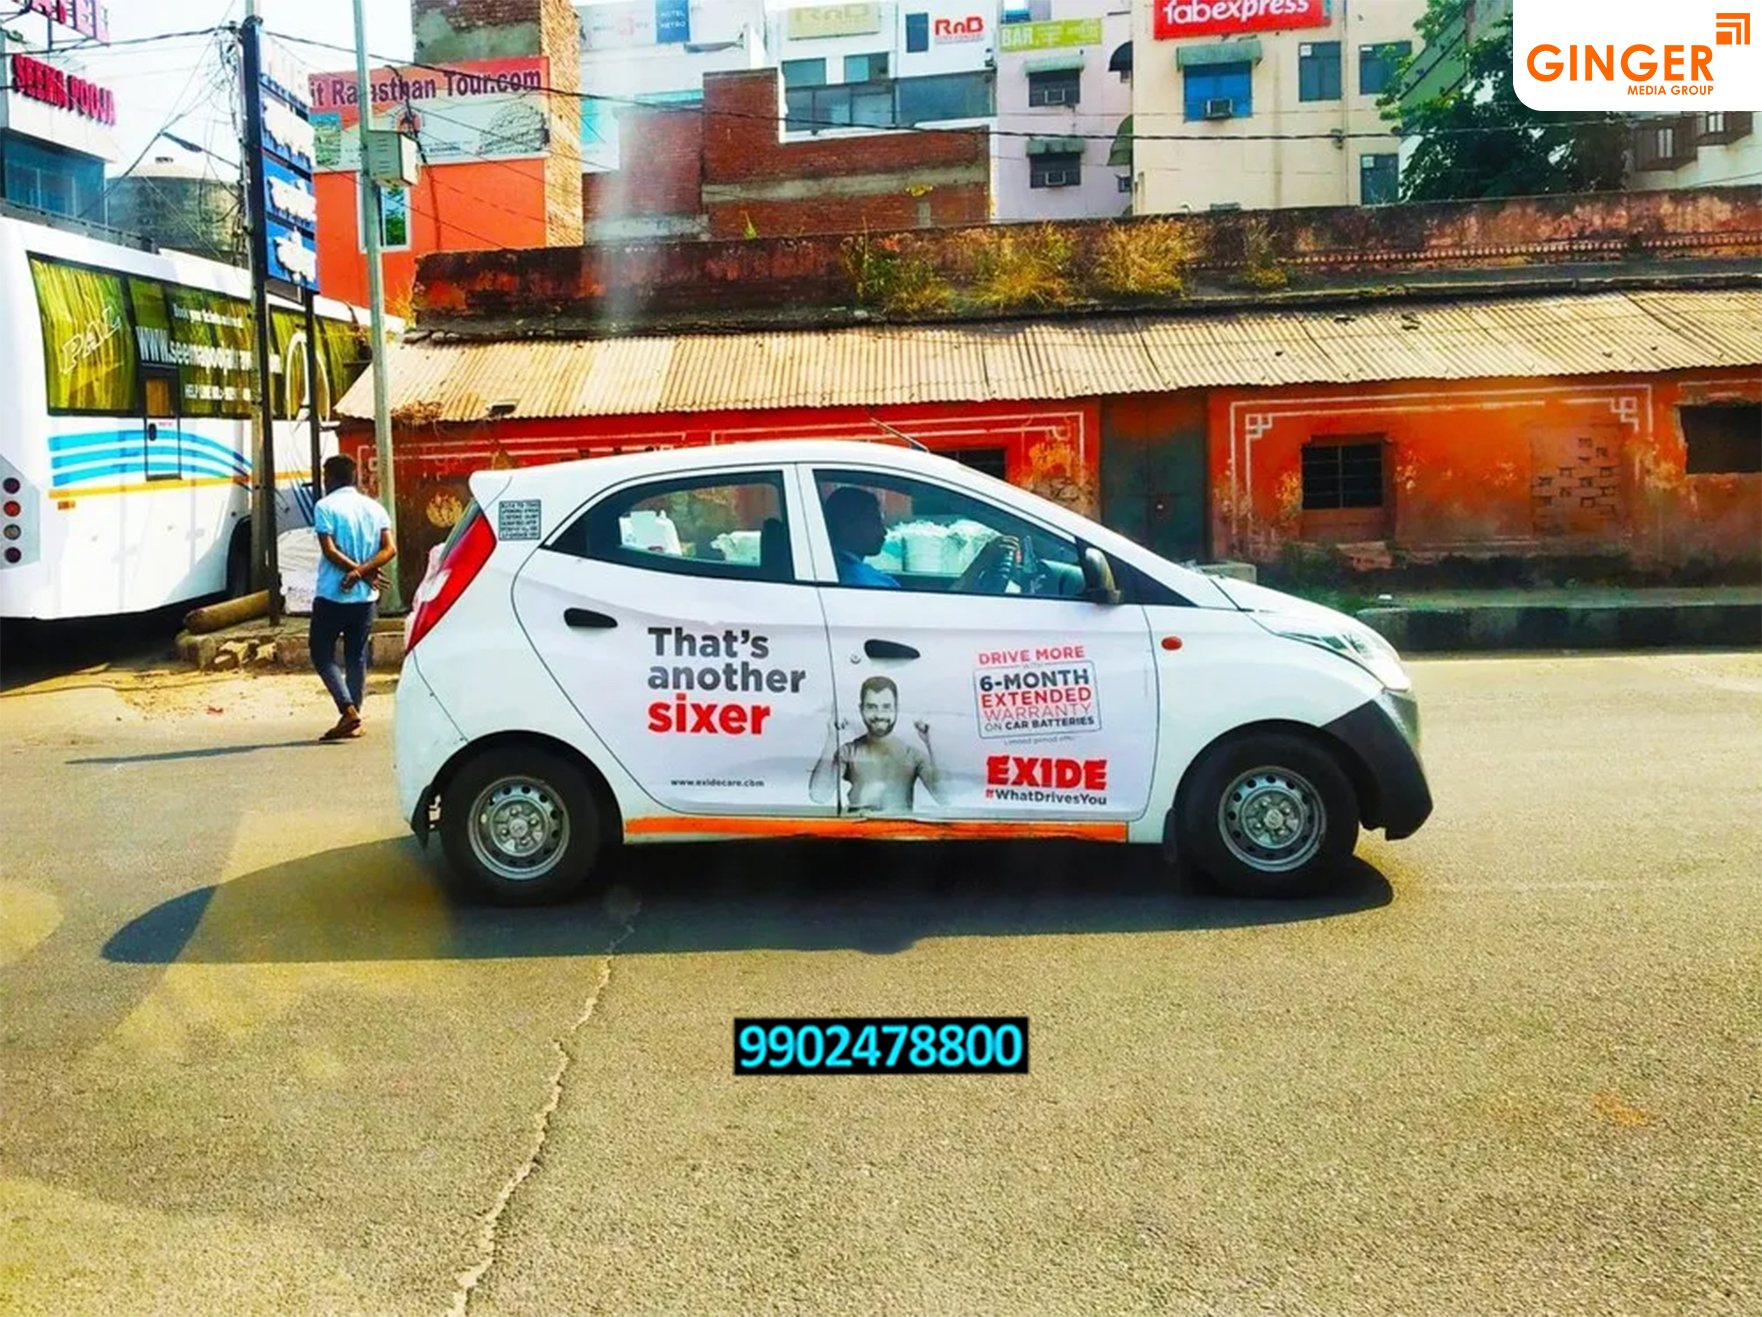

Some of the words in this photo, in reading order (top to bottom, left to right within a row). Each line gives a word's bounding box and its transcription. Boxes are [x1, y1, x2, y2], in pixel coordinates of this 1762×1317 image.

[1163, 0, 1310, 25] fabexpress
[935, 17, 984, 36] RnB
[443, 68, 542, 97] Tour.com
[648, 627, 769, 659] That’s
[979, 650, 1030, 665] DRIVE
[1036, 646, 1085, 661] MORE
[648, 661, 806, 693] another
[980, 668, 1090, 692] 6-MONTH
[981, 686, 1092, 708] EXTENDED
[648, 693, 771, 735] sixer
[984, 703, 1092, 722] WARRANTY
[984, 723, 1002, 732] ON
[1005, 720, 1029, 731] CAR
[1032, 715, 1095, 729] BATTERIES
[987, 756, 1107, 790] EXIDE
[985, 789, 1107, 805] #WhatDrivesYou
